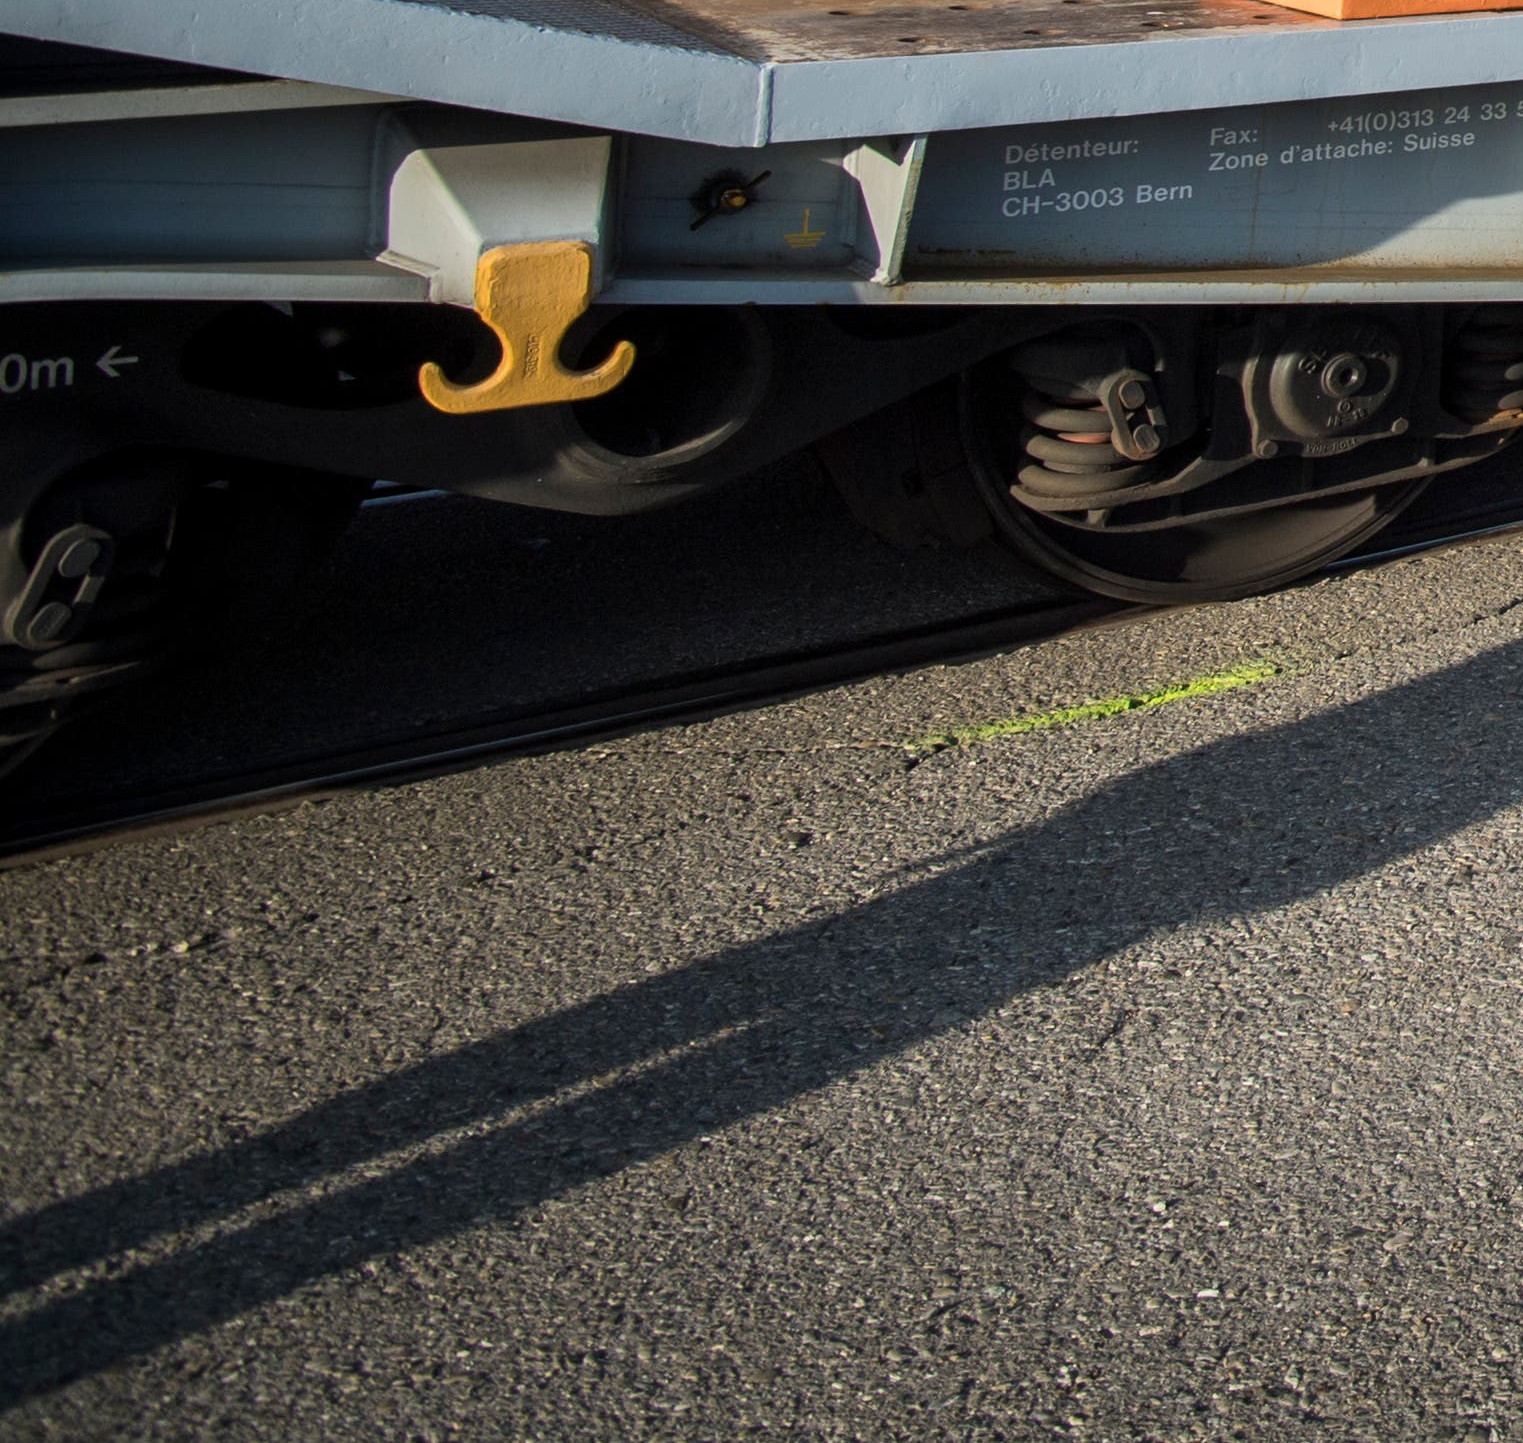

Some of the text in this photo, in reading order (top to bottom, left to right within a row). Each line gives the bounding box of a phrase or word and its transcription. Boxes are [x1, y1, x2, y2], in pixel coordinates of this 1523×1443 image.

[1209, 127, 1259, 146] Fax:
[1327, 108, 1435, 135] +41(0)313
[1443, 106, 1471, 125] 24
[1480, 102, 1507, 121] 33
[1005, 139, 1140, 165] Détenteur:
[1208, 131, 1476, 172] Zone d'attache: Suisse
[1003, 168, 1057, 192] BLA
[1001, 184, 1193, 218] CH-3003 Bern
